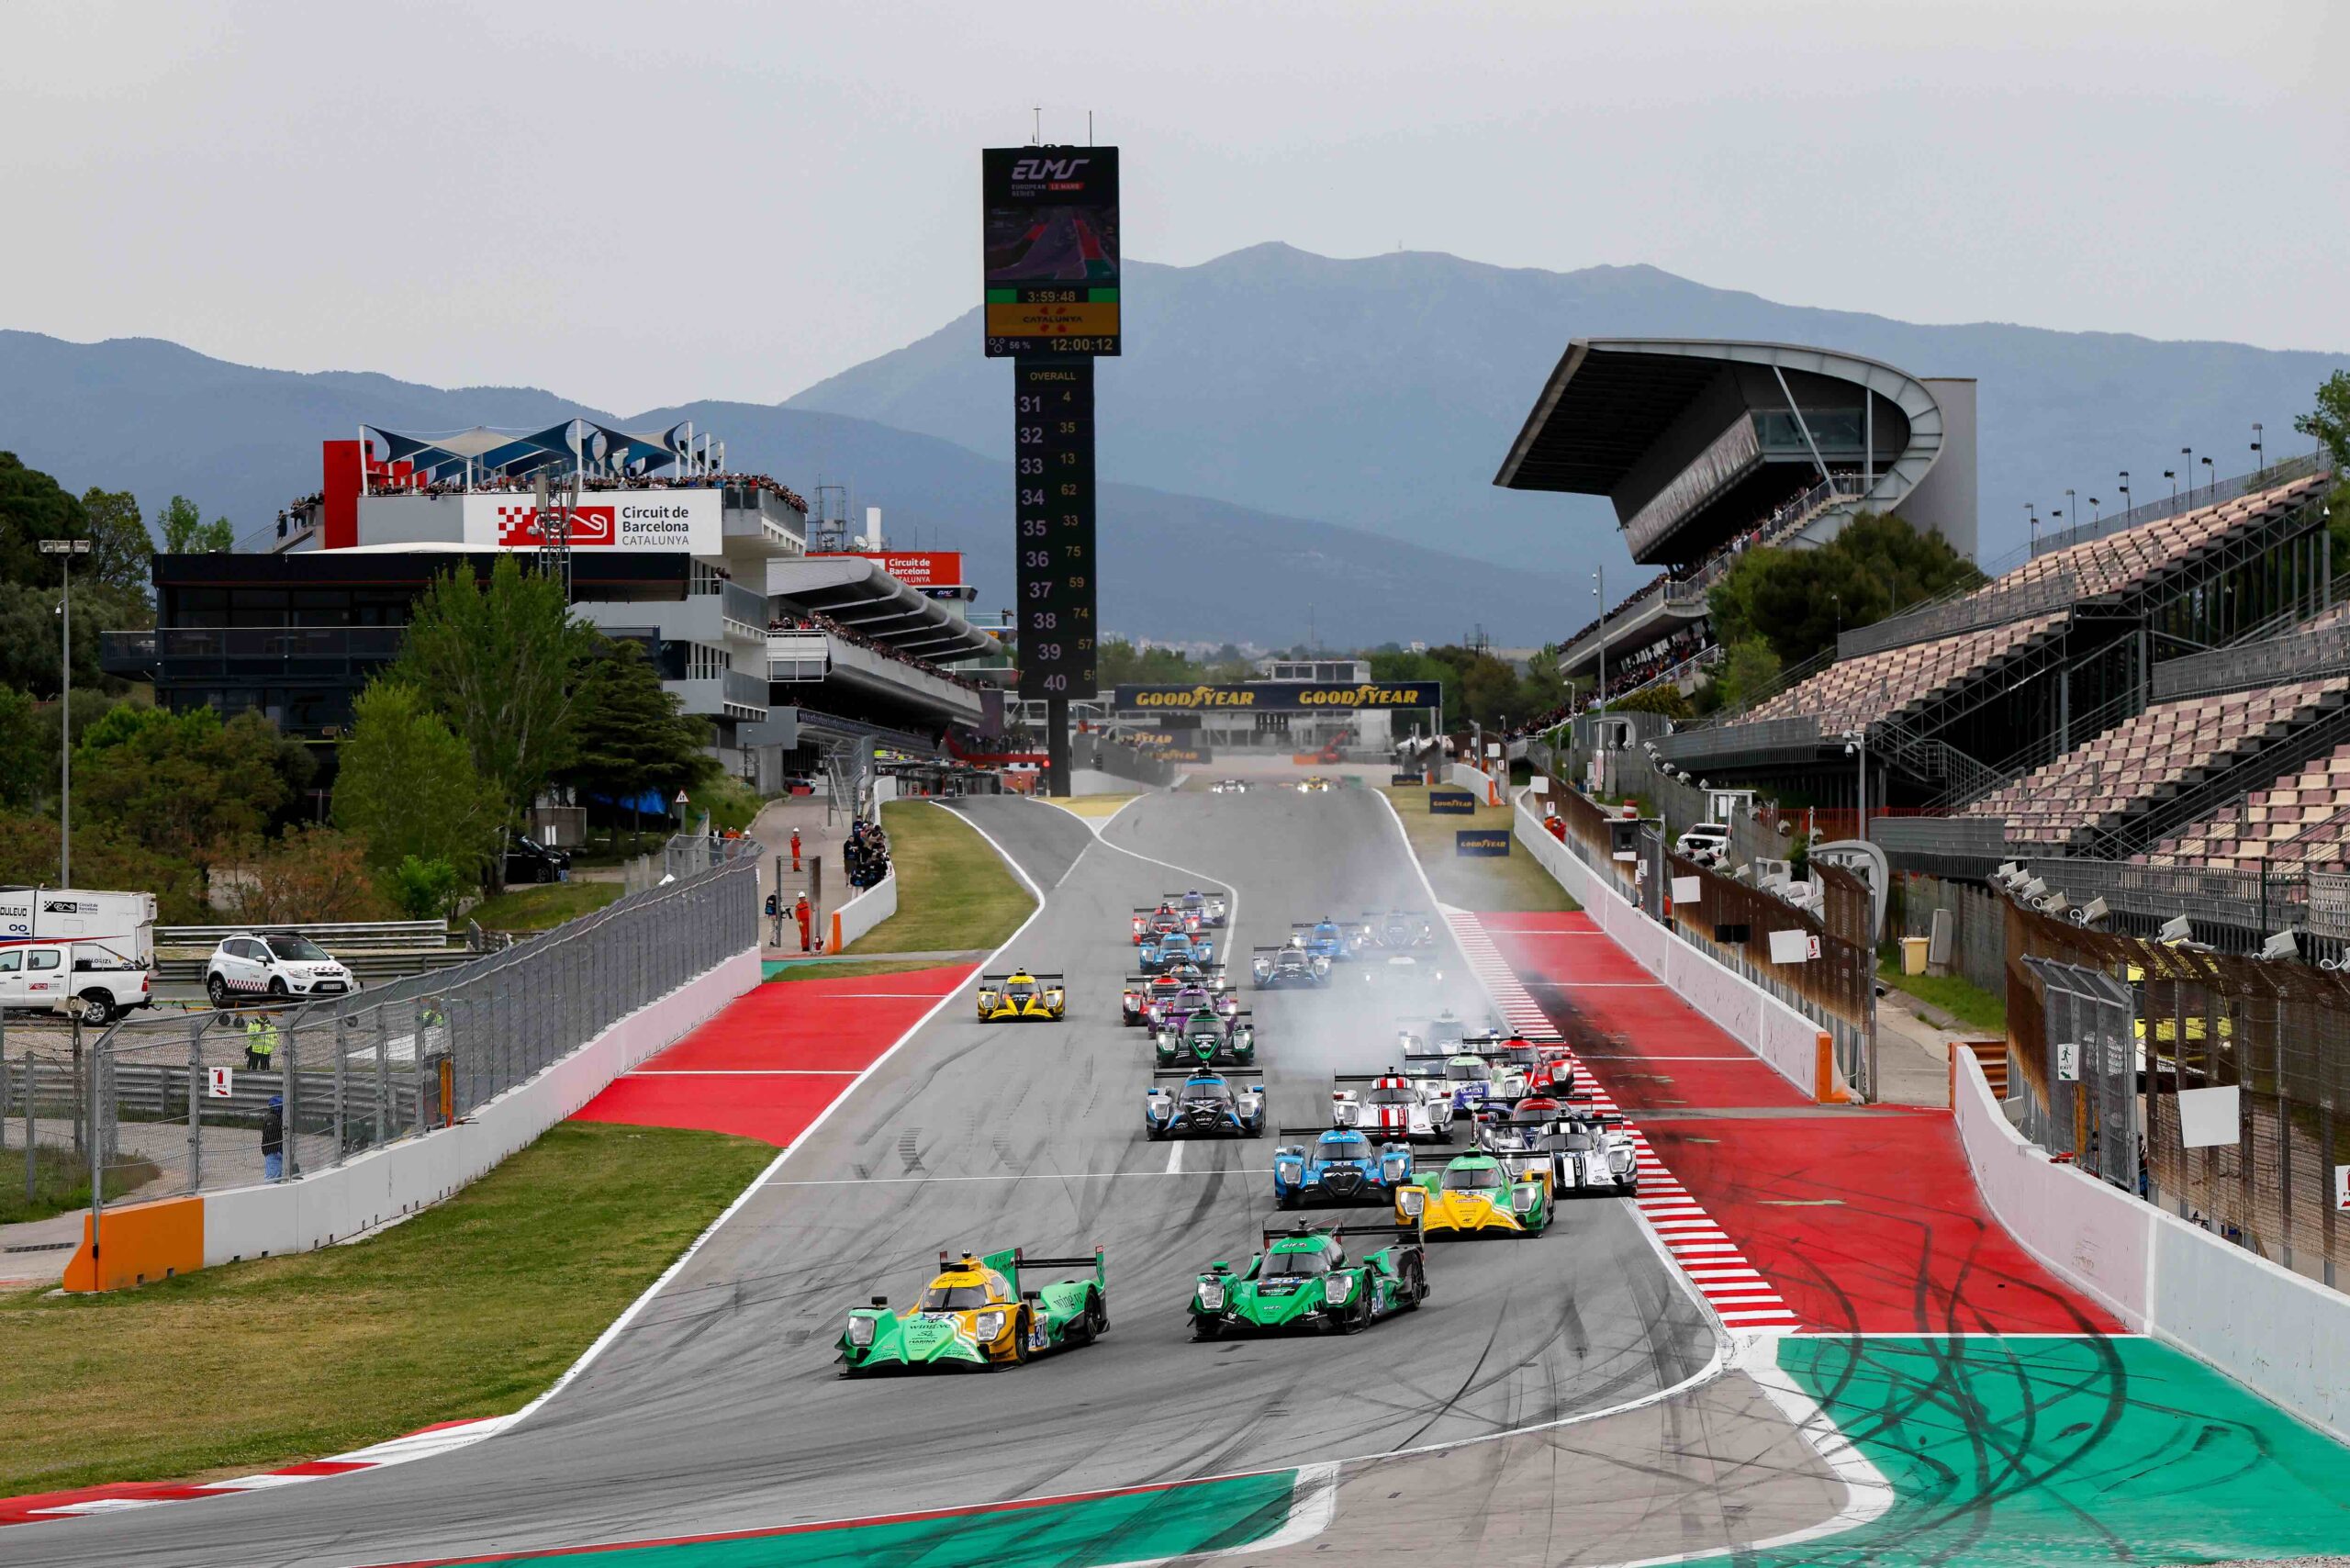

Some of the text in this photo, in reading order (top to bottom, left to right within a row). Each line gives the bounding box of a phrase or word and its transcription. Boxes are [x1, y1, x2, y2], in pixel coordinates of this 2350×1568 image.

[1027, 291, 1076, 302] 3:59:48
[1051, 339, 1113, 351] 12:00:12
[1030, 372, 1077, 381] OVERALL
[1063, 391, 1071, 402] 4
[1020, 396, 1041, 412] 31
[1059, 422, 1076, 433] 35
[1020, 427, 1043, 443] 32
[1060, 454, 1075, 464] 13
[1020, 458, 1043, 474] 33
[1060, 484, 1077, 496] 62
[1022, 488, 1045, 505] 34
[622, 506, 688, 519] Circuit de
[622, 521, 688, 532] Barcelona
[1063, 515, 1078, 526] 33
[1024, 520, 1046, 536] 35
[622, 535, 689, 546] CATALUNYA
[1065, 546, 1081, 557] 75
[889, 558, 930, 566] Circuit de
[1026, 551, 1049, 567] 36
[890, 567, 930, 576] Barcelona
[1069, 577, 1085, 588] 59
[1029, 582, 1052, 598] 37
[1073, 608, 1089, 619] 74
[1034, 612, 1057, 629] 38
[1078, 639, 1093, 650] 57
[1038, 644, 1061, 660] 39
[1044, 675, 1067, 690] 40
[1136, 686, 1255, 707] GOODYEAR
[1299, 685, 1418, 706] GOODYEAR
[1054, 1292, 1083, 1310] wing.vc
